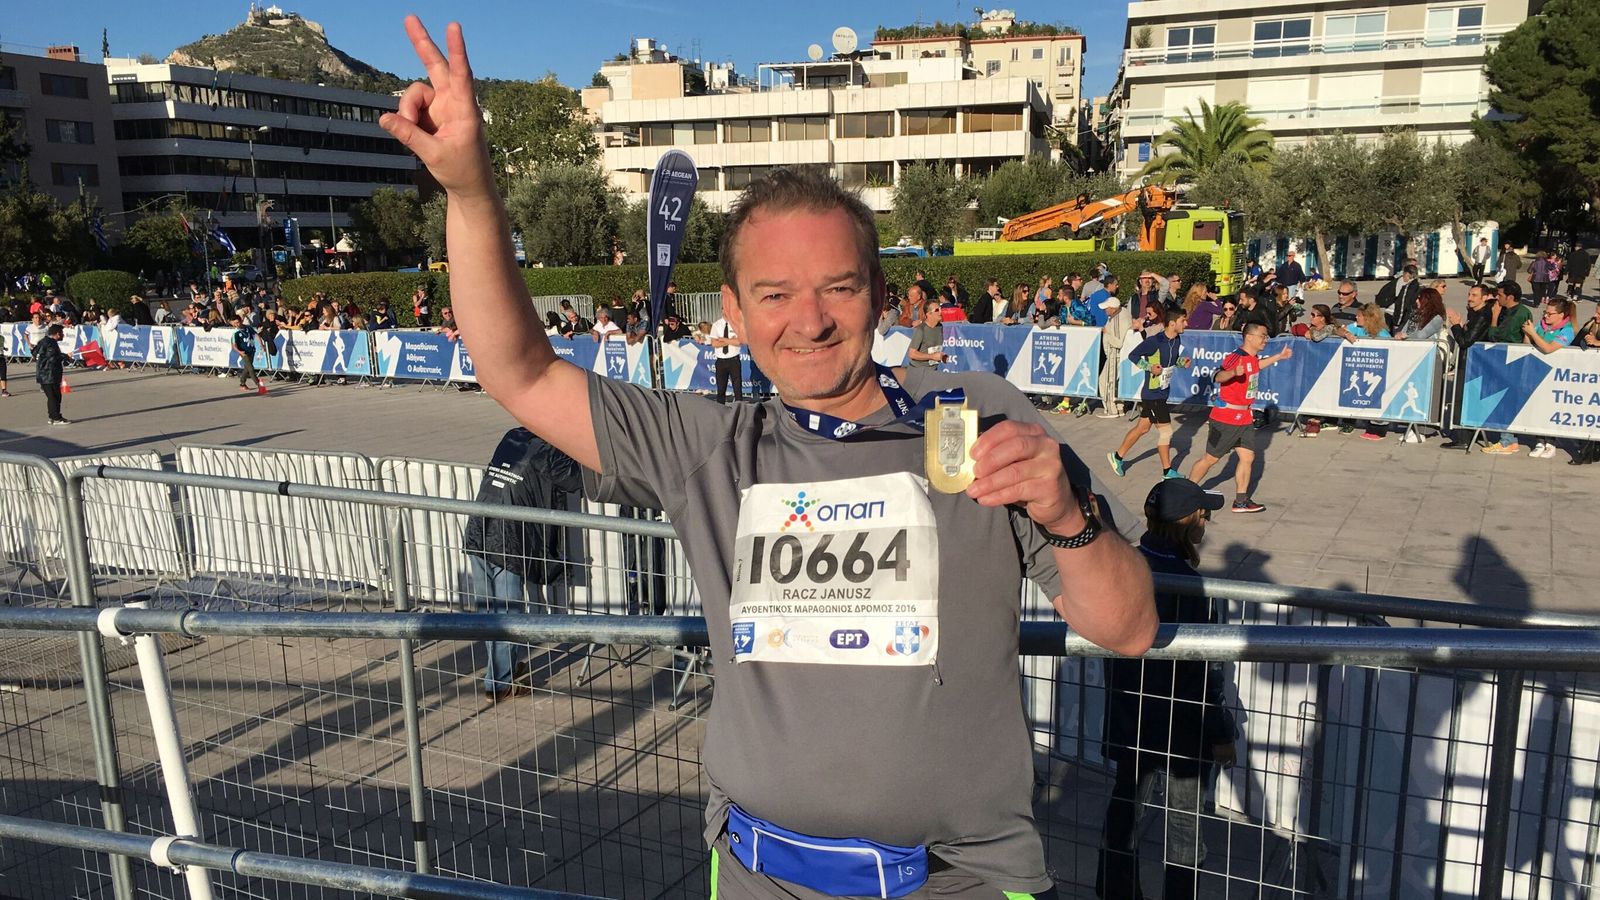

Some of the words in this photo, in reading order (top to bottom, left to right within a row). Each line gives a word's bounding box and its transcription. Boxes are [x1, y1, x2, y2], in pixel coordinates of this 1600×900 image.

[658, 196, 682, 221] 42
[664, 221, 676, 231] km
[1554, 367, 1600, 383] Mara
[1551, 389, 1583, 405] The
[750, 529, 911, 584] 10664
[782, 588, 817, 600] RACZ
[820, 588, 872, 600] JANUSZ
[794, 604, 853, 614] ΜΑΡΑΘΩΝΙΟΣ
[854, 604, 893, 613] ΔΡΟΜΟΣ
[895, 603, 917, 613] 2016
